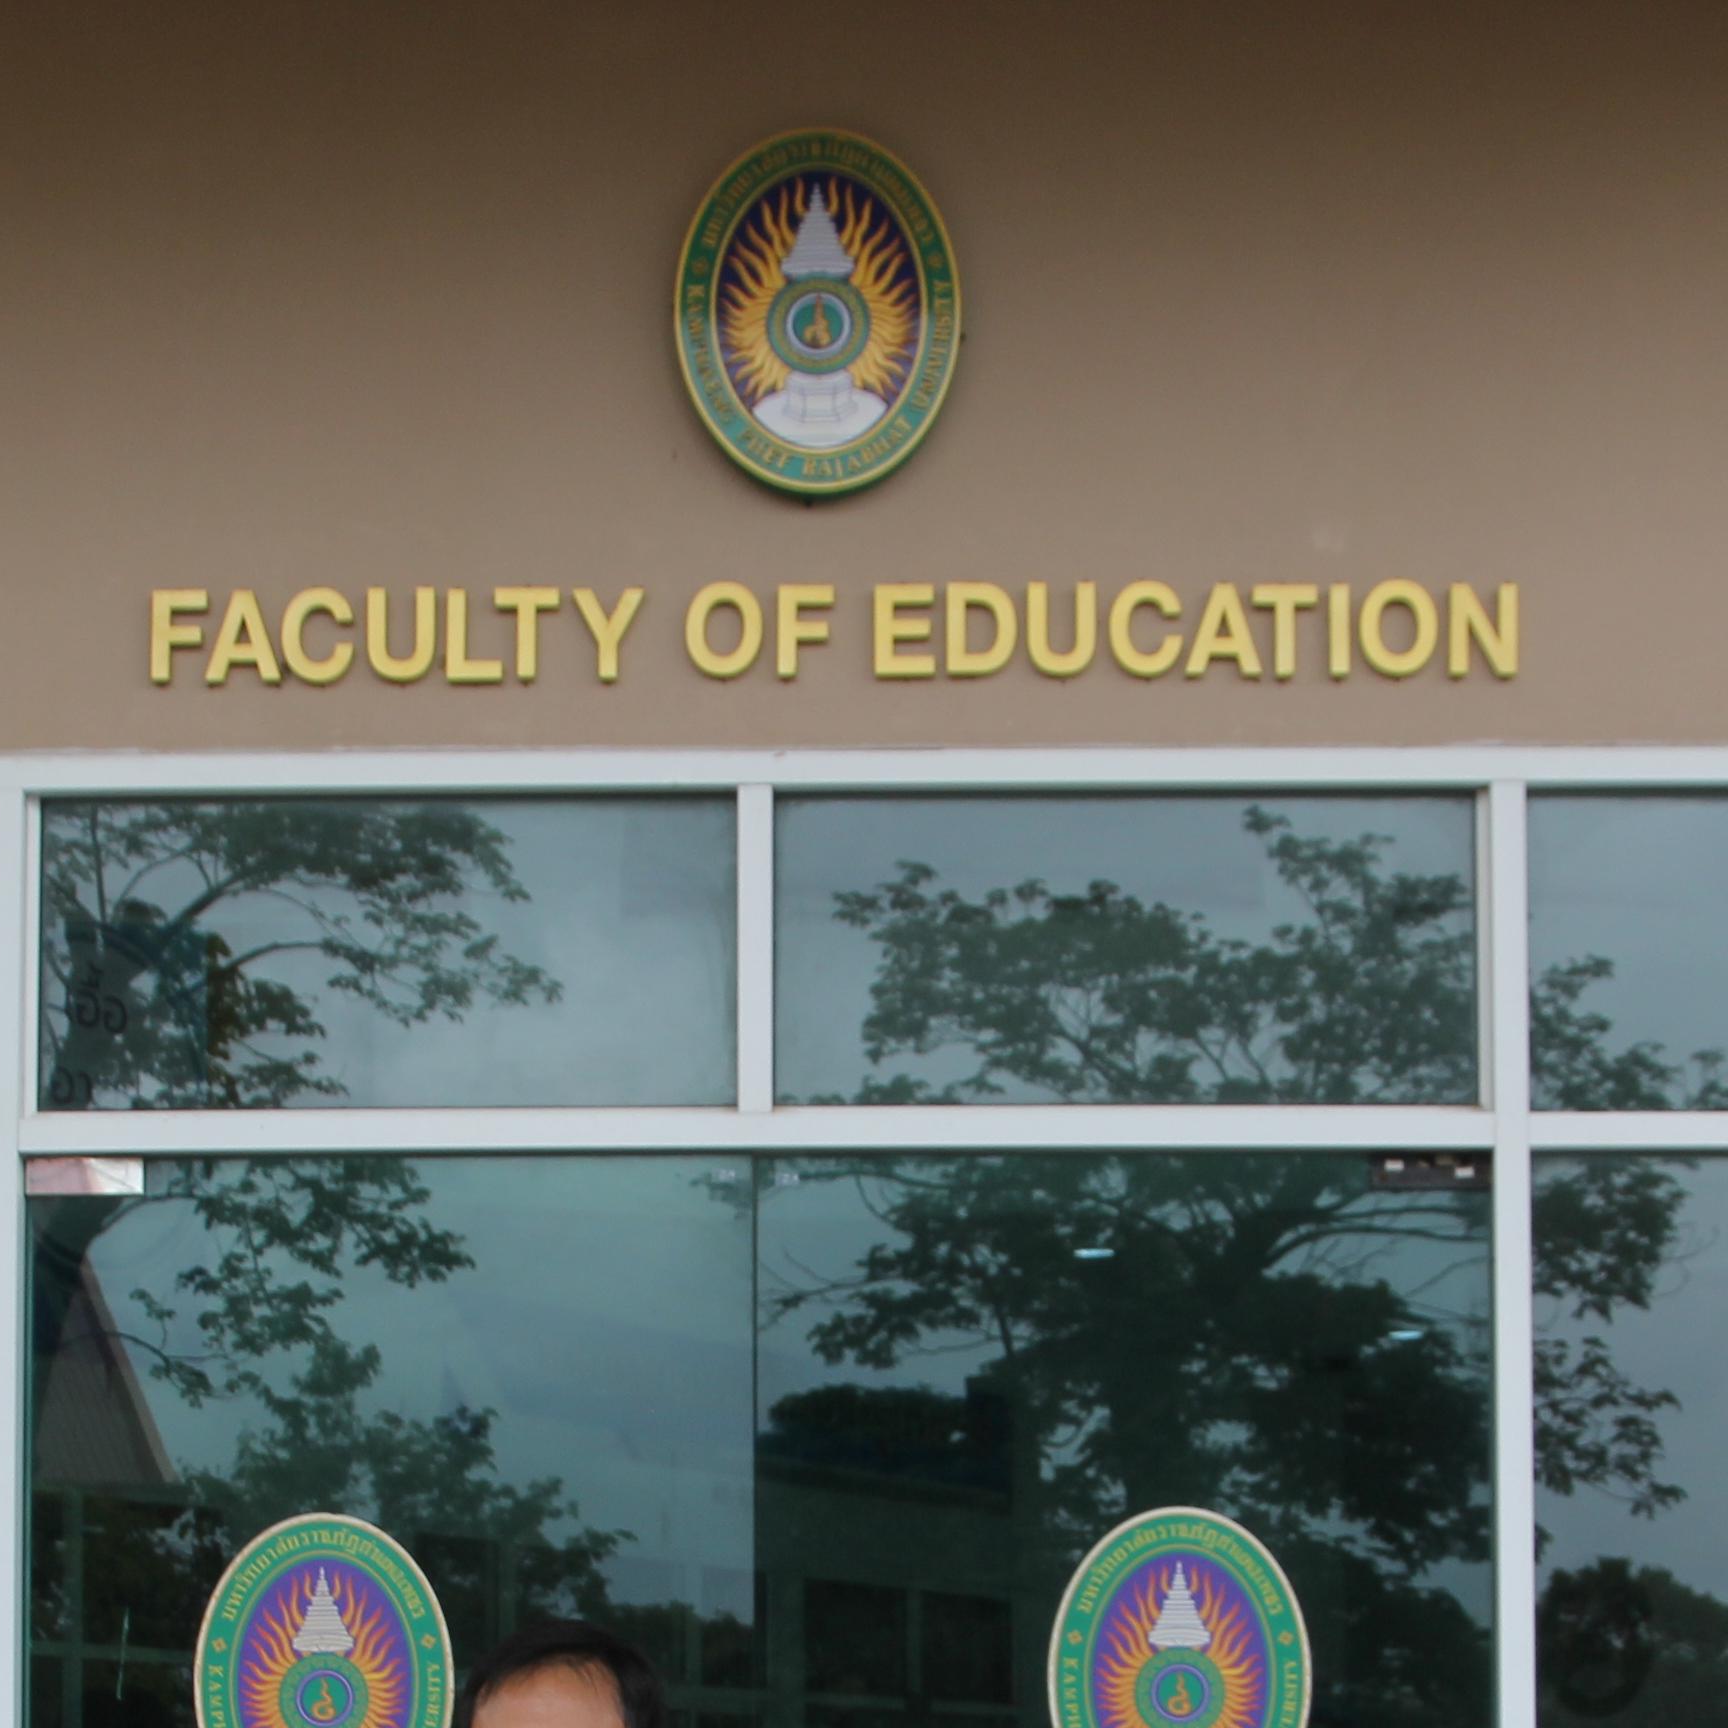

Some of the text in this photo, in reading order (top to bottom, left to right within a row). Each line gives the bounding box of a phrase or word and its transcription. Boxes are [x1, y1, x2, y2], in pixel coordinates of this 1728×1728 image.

[149, 580, 1520, 687] FACULTY OF EDUCATION
